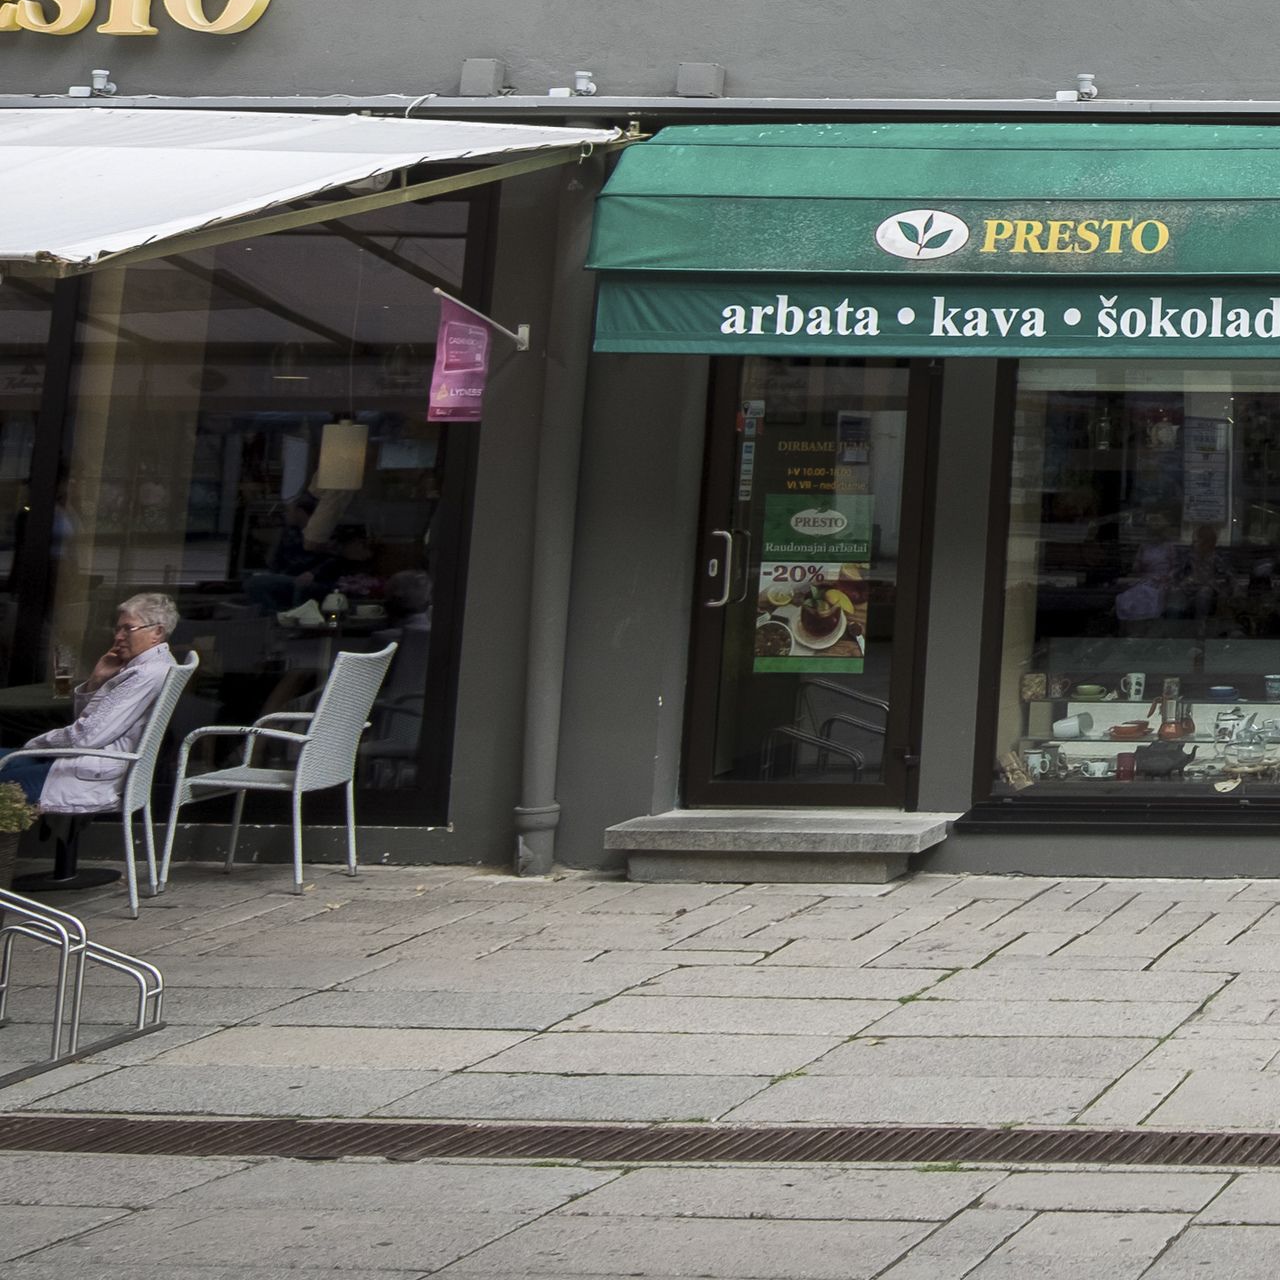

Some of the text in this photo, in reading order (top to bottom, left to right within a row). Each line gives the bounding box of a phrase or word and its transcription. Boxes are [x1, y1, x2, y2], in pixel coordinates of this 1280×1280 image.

[979, 219, 1169, 254] PRESTO
[720, 294, 881, 337] arbata
[929, 295, 1047, 338] kava
[777, 440, 836, 452] DIRBAME
[794, 516, 845, 528] PRESTO
[765, 542, 827, 555] Raudonajai
[762, 565, 825, 583] -20%
